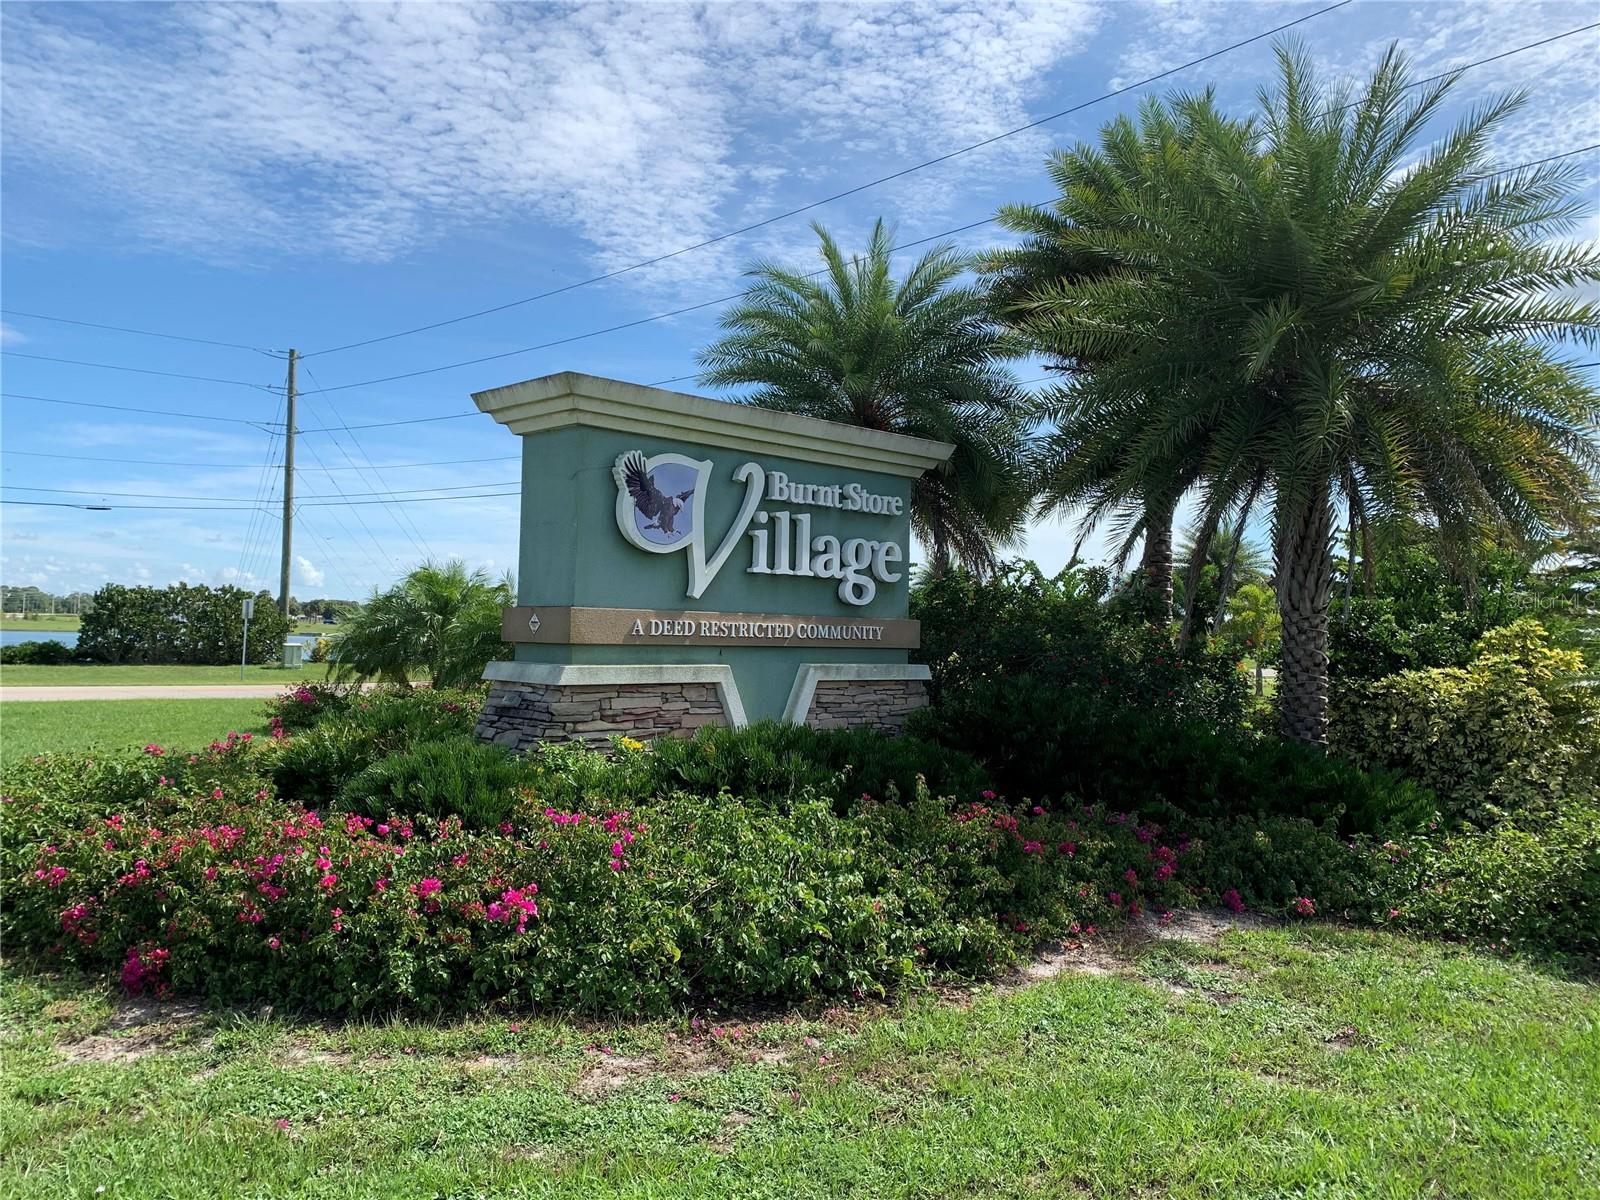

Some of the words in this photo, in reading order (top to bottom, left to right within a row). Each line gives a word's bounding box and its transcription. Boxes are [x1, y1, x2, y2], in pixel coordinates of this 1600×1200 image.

[766, 471, 842, 508] Burnt
[843, 483, 903, 515] Store
[616, 452, 903, 606] Village
[632, 618, 645, 636] A
[649, 619, 696, 637] DEED
[699, 621, 795, 639] RESTRICTED
[796, 623, 884, 641] COMMUNITY
